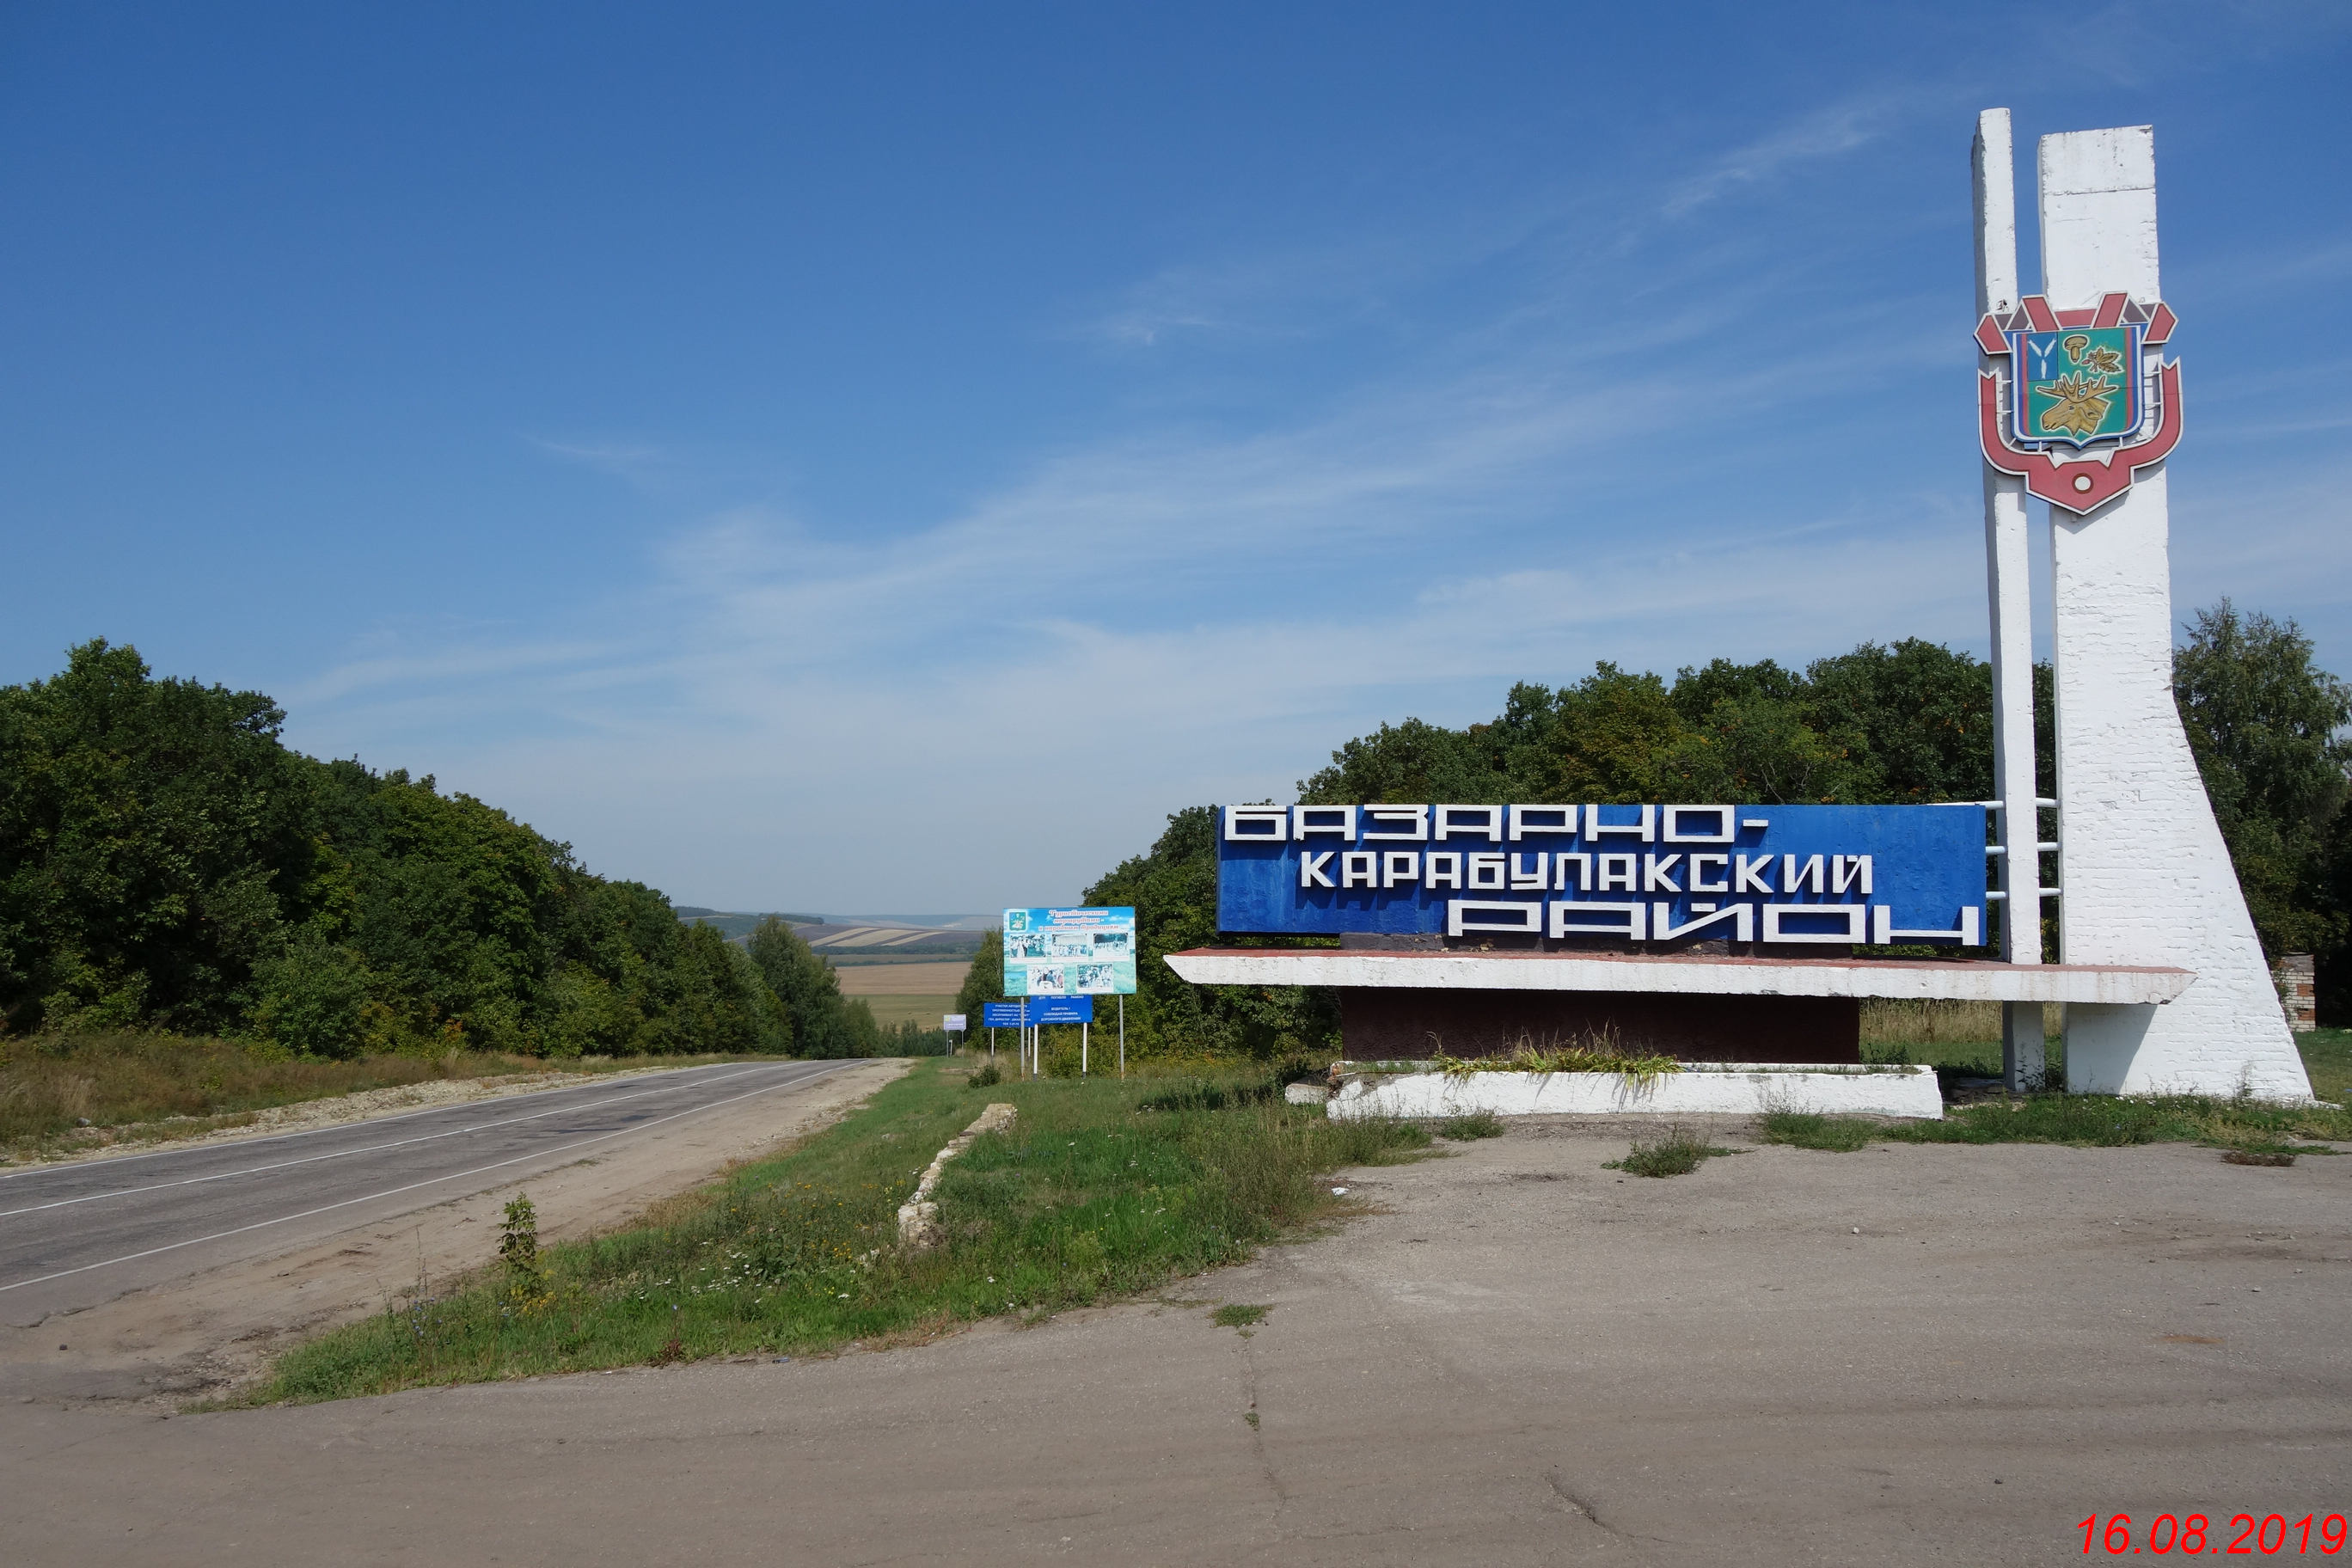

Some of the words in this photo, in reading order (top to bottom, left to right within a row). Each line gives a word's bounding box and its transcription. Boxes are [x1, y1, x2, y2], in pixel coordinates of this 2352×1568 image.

[1224, 804, 1769, 843] БАЗАРНО-
[1301, 851, 1873, 895] КАРАБУЛАКСКИЙ
[1448, 899, 1979, 946] РАЙОН
